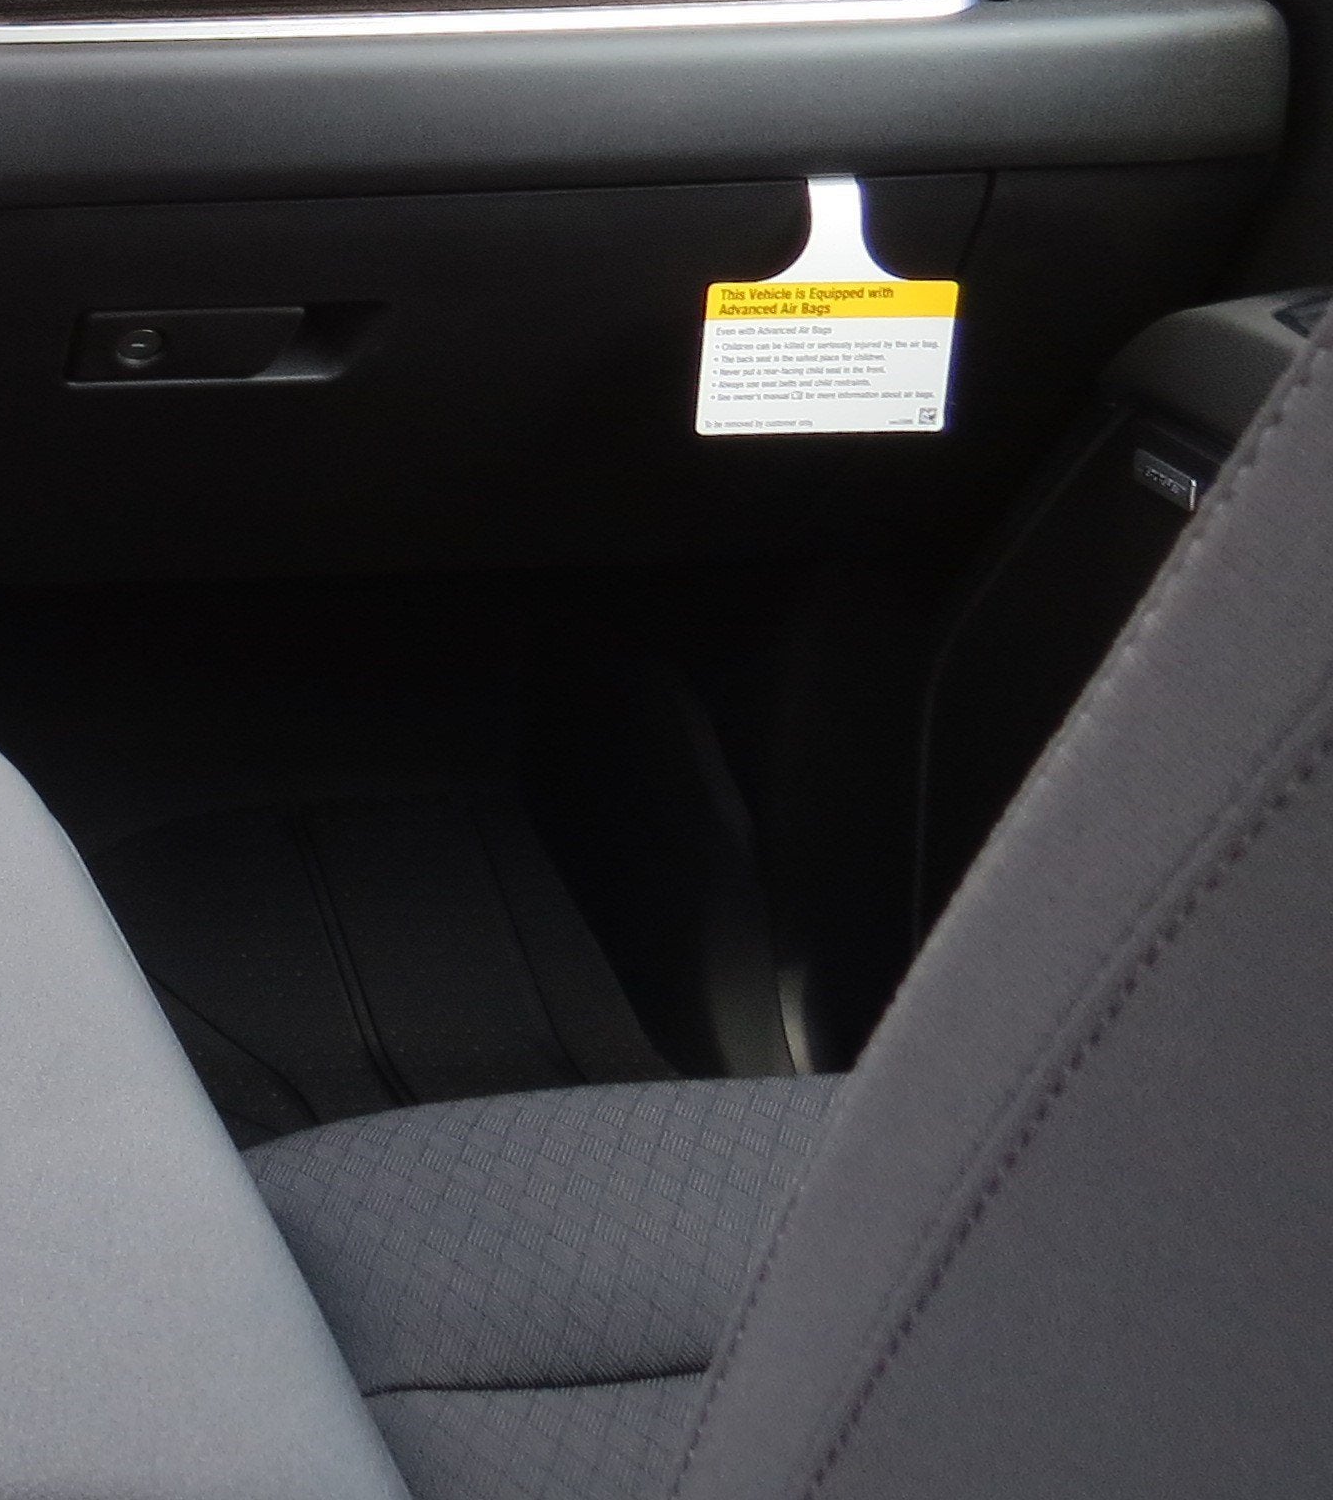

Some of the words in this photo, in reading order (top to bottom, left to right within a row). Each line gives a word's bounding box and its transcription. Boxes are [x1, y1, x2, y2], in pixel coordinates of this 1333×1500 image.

[722, 289, 744, 300] This
[750, 289, 791, 300] Vehicle
[797, 288, 805, 299] is
[809, 288, 864, 301] Equipped
[868, 287, 894, 298] with
[719, 304, 776, 315] Advanced
[781, 303, 797, 314] Air
[802, 304, 830, 316] Bags
